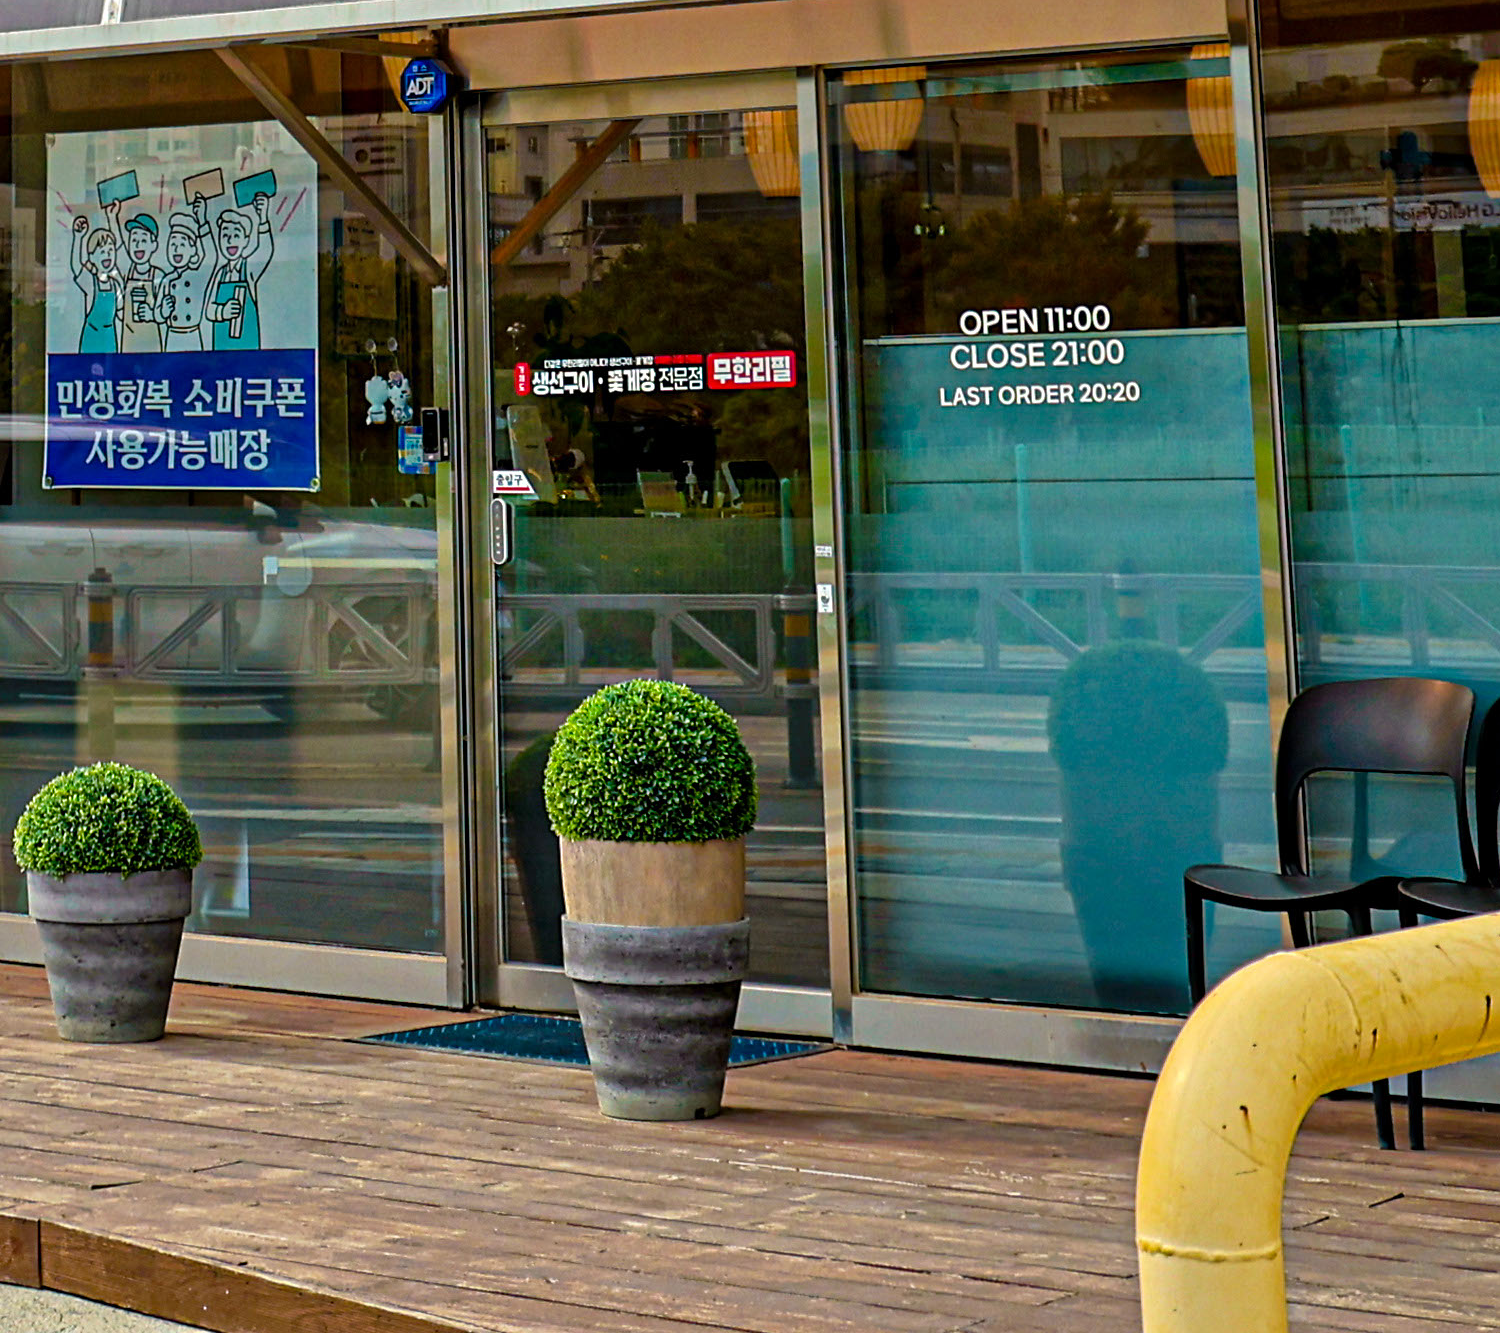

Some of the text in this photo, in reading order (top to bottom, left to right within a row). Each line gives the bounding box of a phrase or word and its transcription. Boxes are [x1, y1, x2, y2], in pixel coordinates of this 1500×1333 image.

[406, 77, 434, 96] ADT
[959, 305, 1111, 336] OPEN 11:00
[950, 339, 1125, 370] CLOSE 21:00
[532, 370, 594, 395] 생선구이
[608, 368, 656, 393] 꽃게장
[658, 366, 703, 391] 전문점
[713, 356, 791, 384] 무한리필
[57, 378, 307, 420] 민생회복 소비쿠폰
[939, 382, 1140, 407] LAST ORDER 20:20
[86, 429, 271, 471] 사용가능매장
